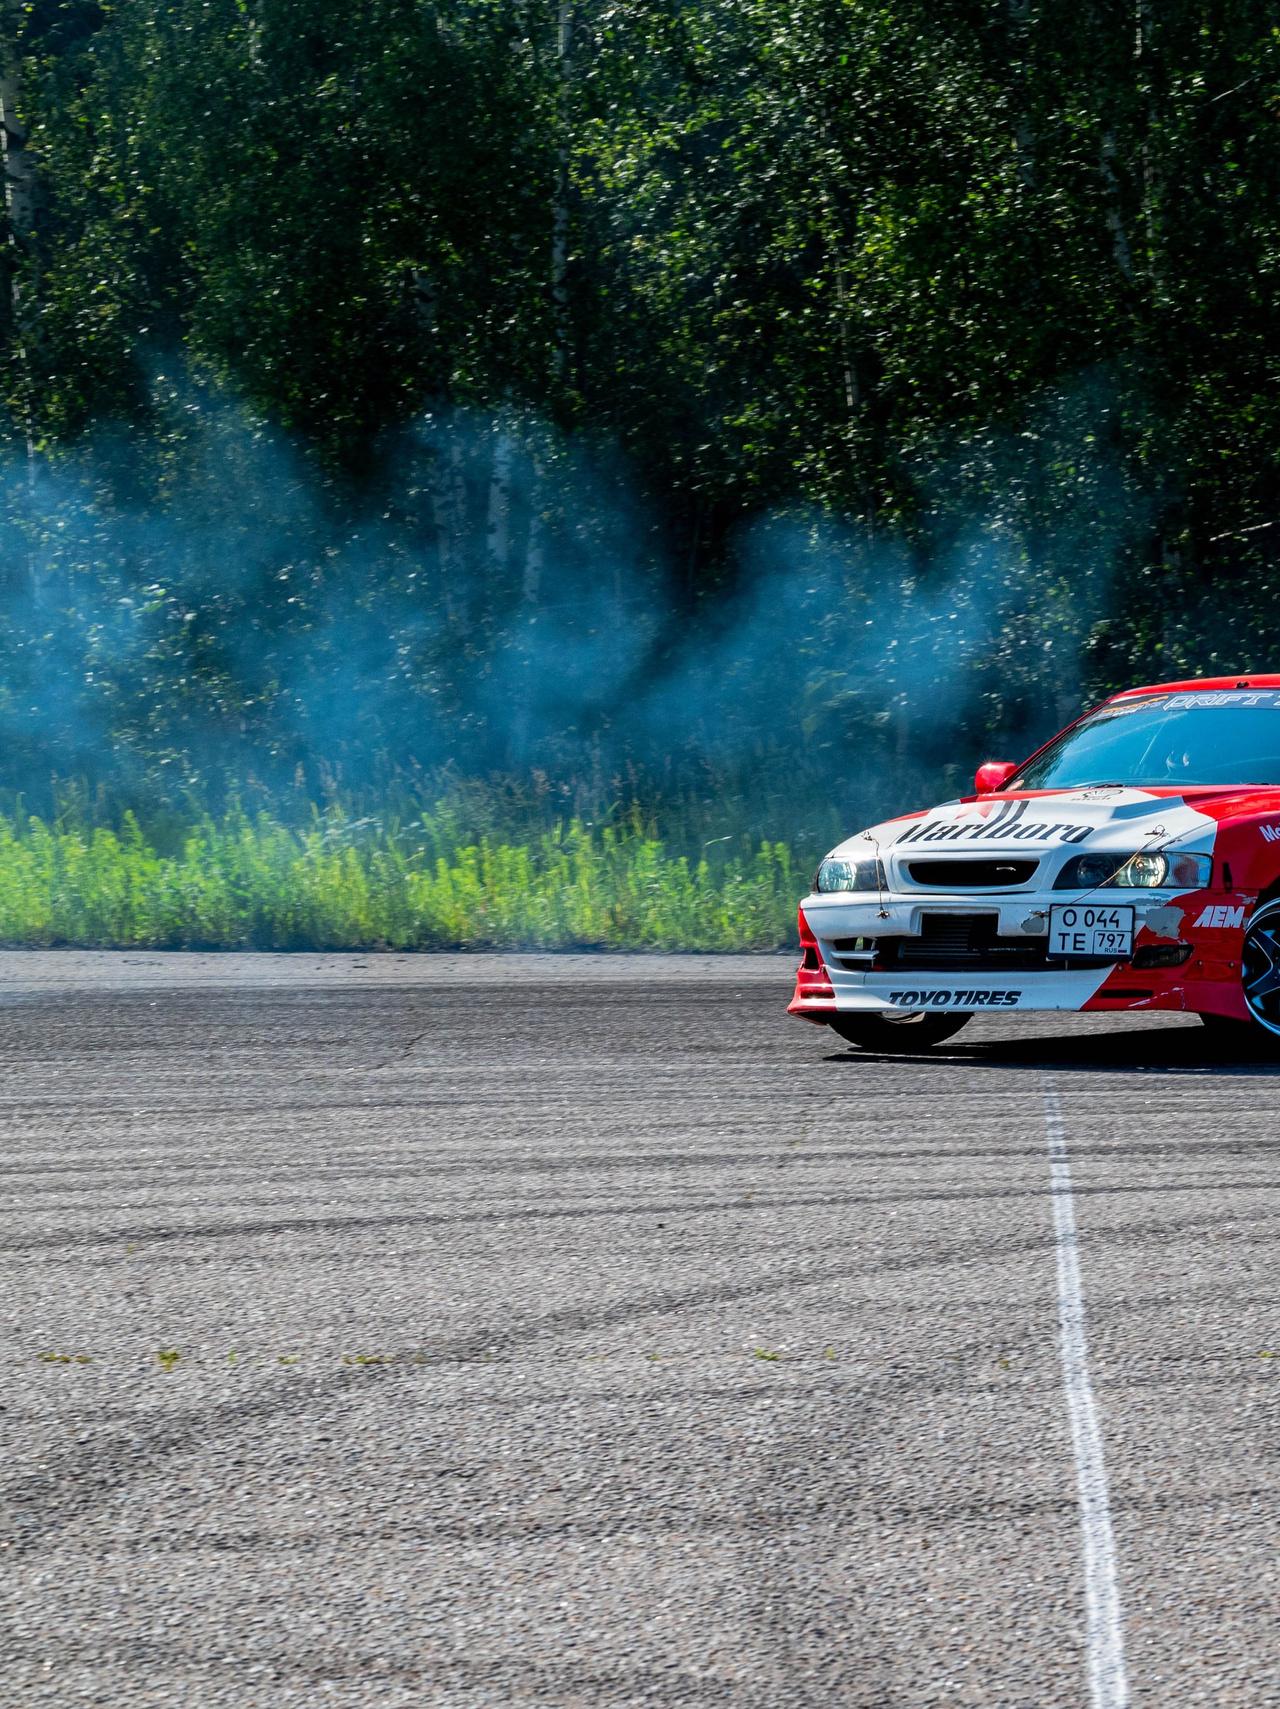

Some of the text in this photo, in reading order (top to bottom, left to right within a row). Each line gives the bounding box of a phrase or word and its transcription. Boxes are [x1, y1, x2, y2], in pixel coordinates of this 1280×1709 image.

[1162, 692, 1274, 711] DRIFT
[889, 800, 1095, 849] Marlboro
[1062, 909, 1120, 928] O 044
[1192, 905, 1246, 929] AEM
[1058, 932, 1086, 951] TE
[1097, 933, 1125, 948] 797
[889, 990, 1022, 1006] TOYO TIRES
